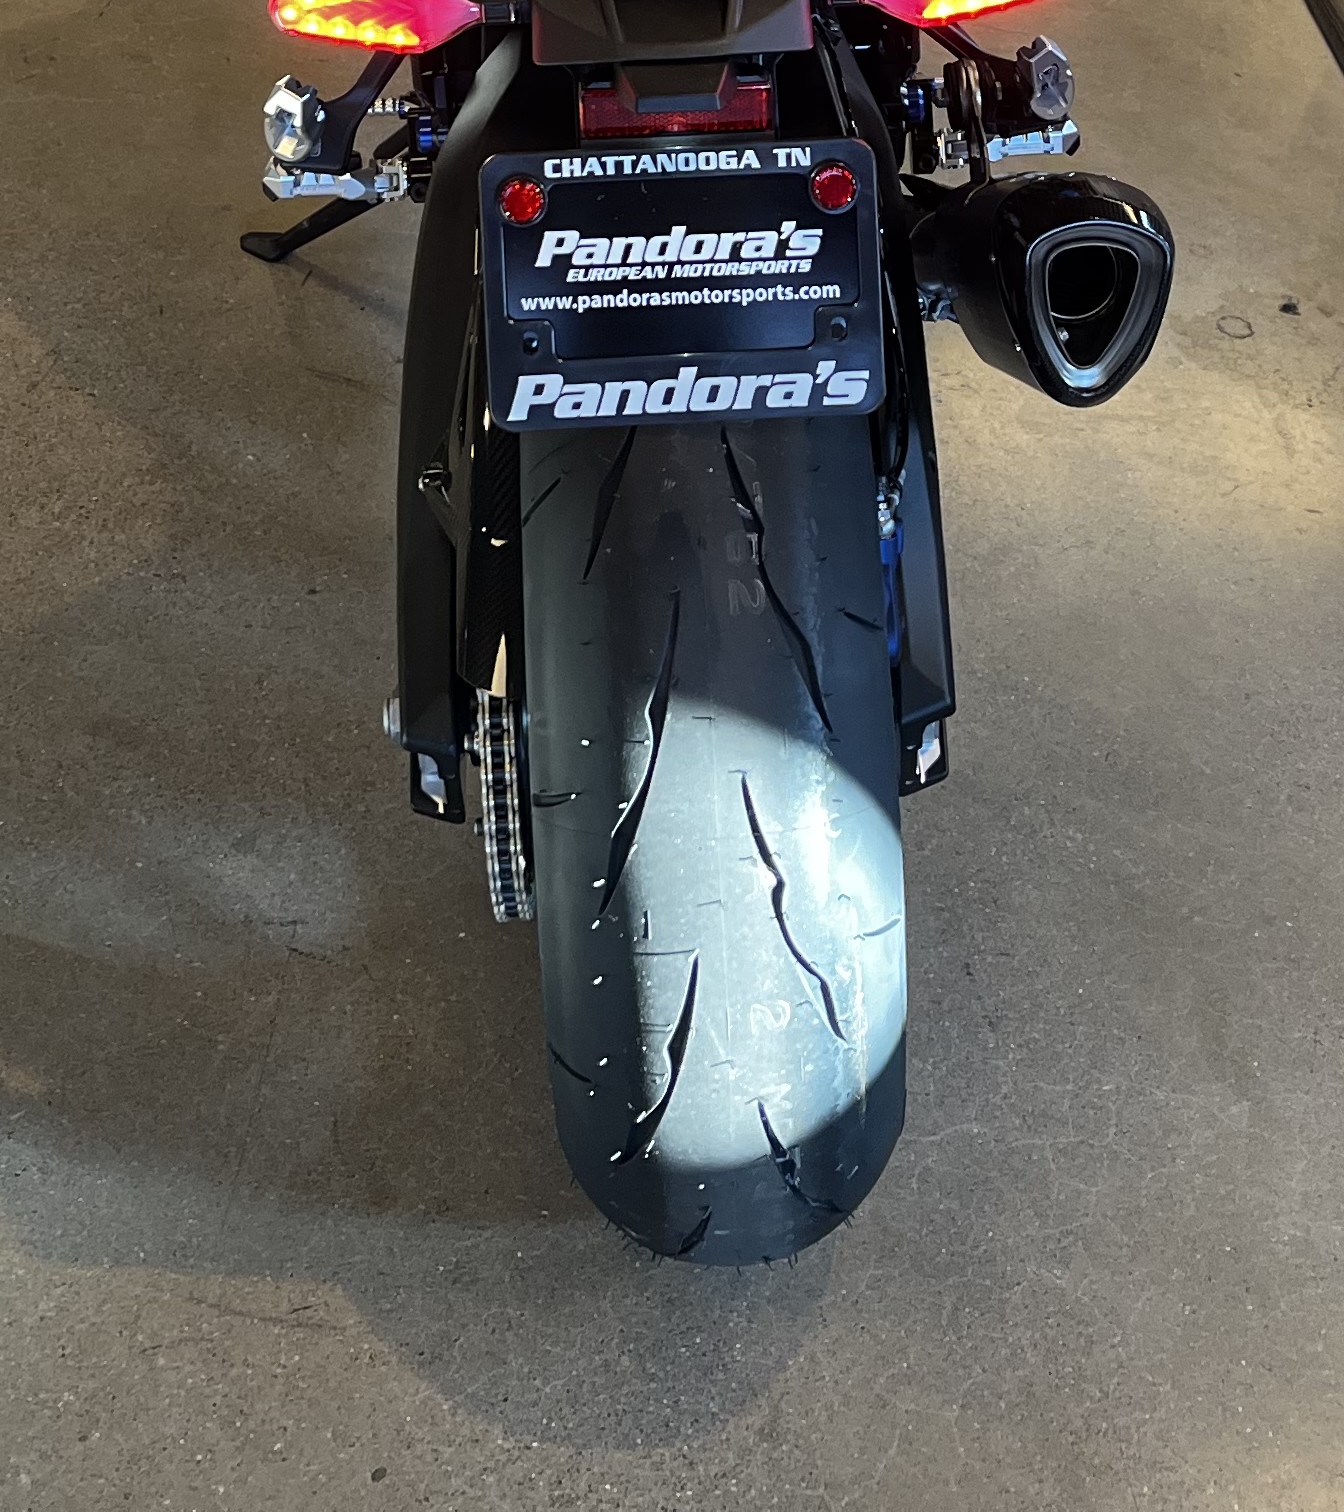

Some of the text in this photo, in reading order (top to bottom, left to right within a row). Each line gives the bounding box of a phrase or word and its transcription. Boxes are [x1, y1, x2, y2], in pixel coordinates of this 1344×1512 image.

[544, 147, 811, 179] CHATTANOOGA TN
[534, 221, 823, 268] Pandora's
[566, 259, 813, 284] EUROPEAN MOTORSPORTS
[521, 282, 841, 314] www.pandorasmotorsports.com
[507, 360, 870, 422] Pandora's
